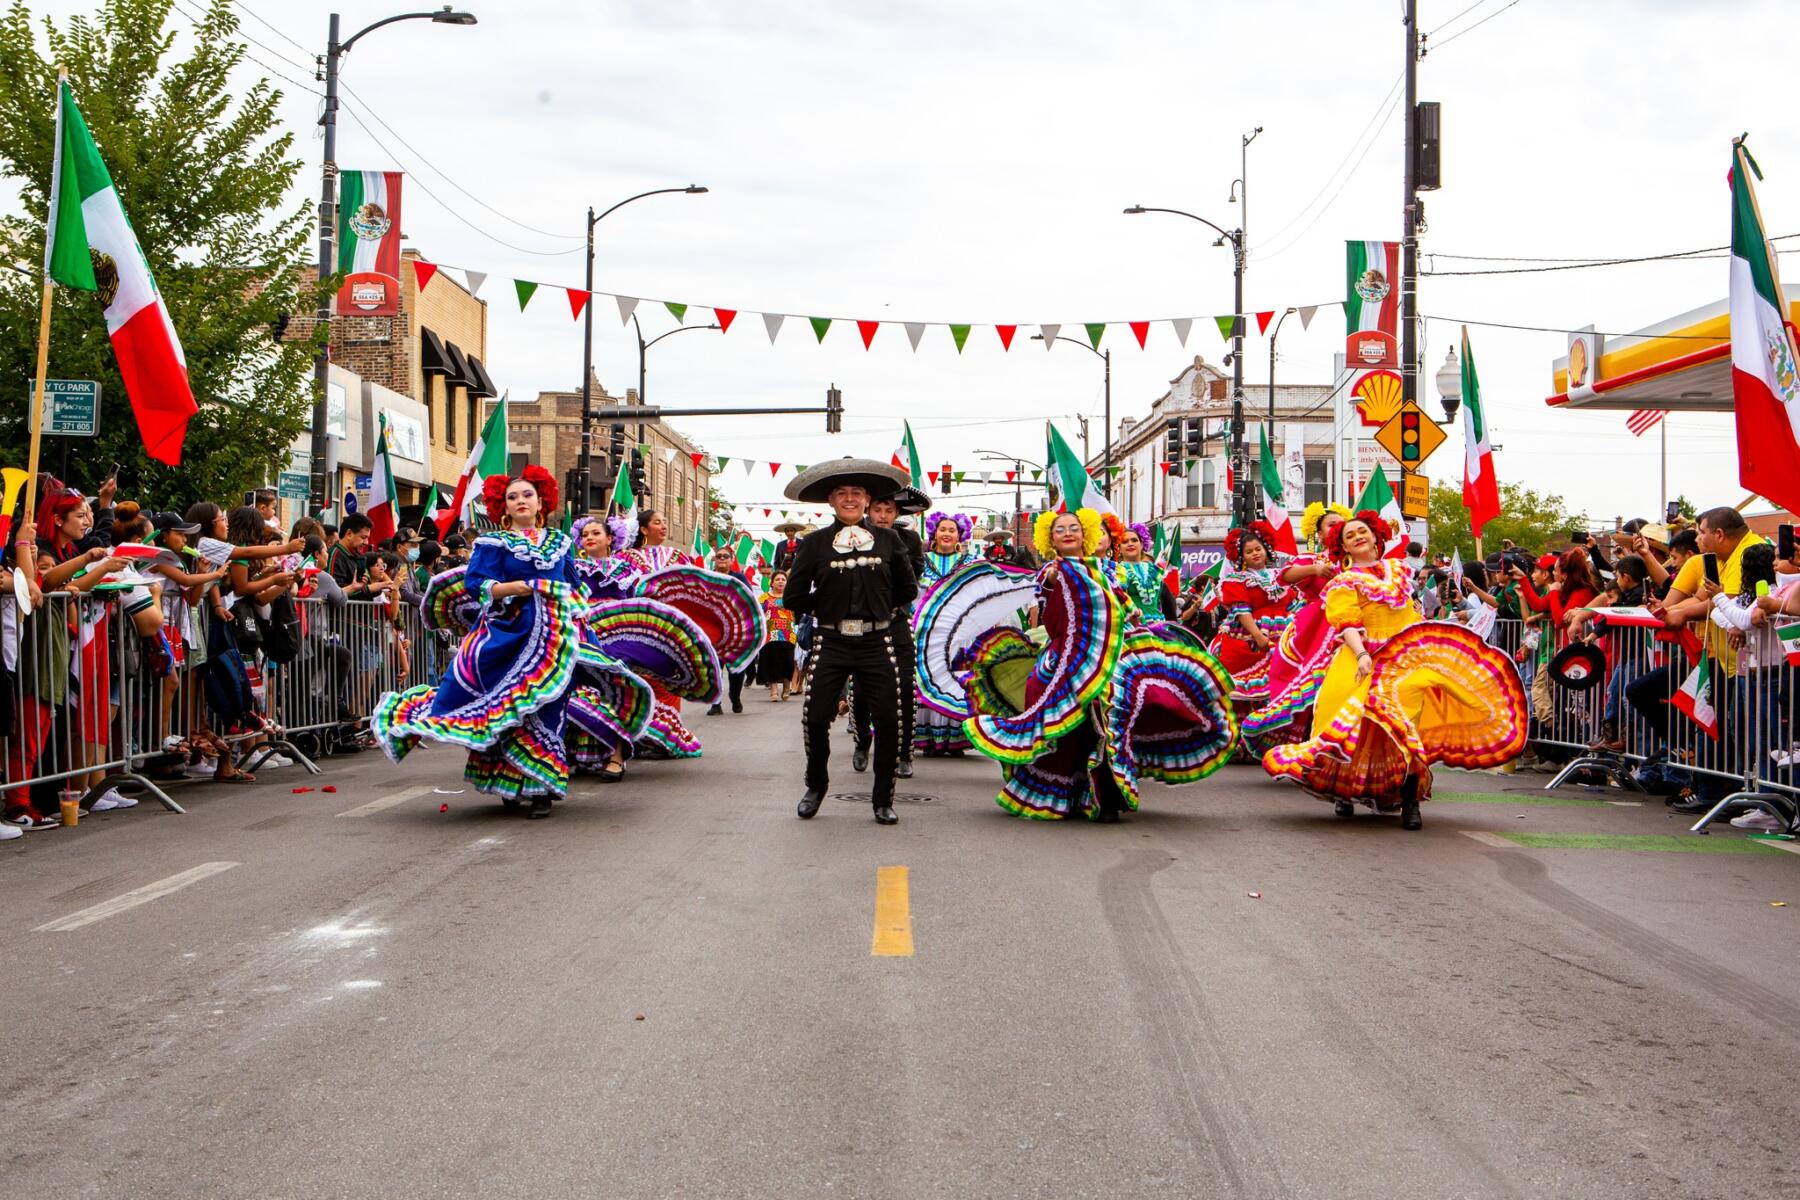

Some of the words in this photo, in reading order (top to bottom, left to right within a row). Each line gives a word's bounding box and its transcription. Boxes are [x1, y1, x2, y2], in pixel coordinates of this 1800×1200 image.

[54, 383, 65, 391] TO
[67, 383, 91, 391] PARK
[62, 422, 75, 430] 371
